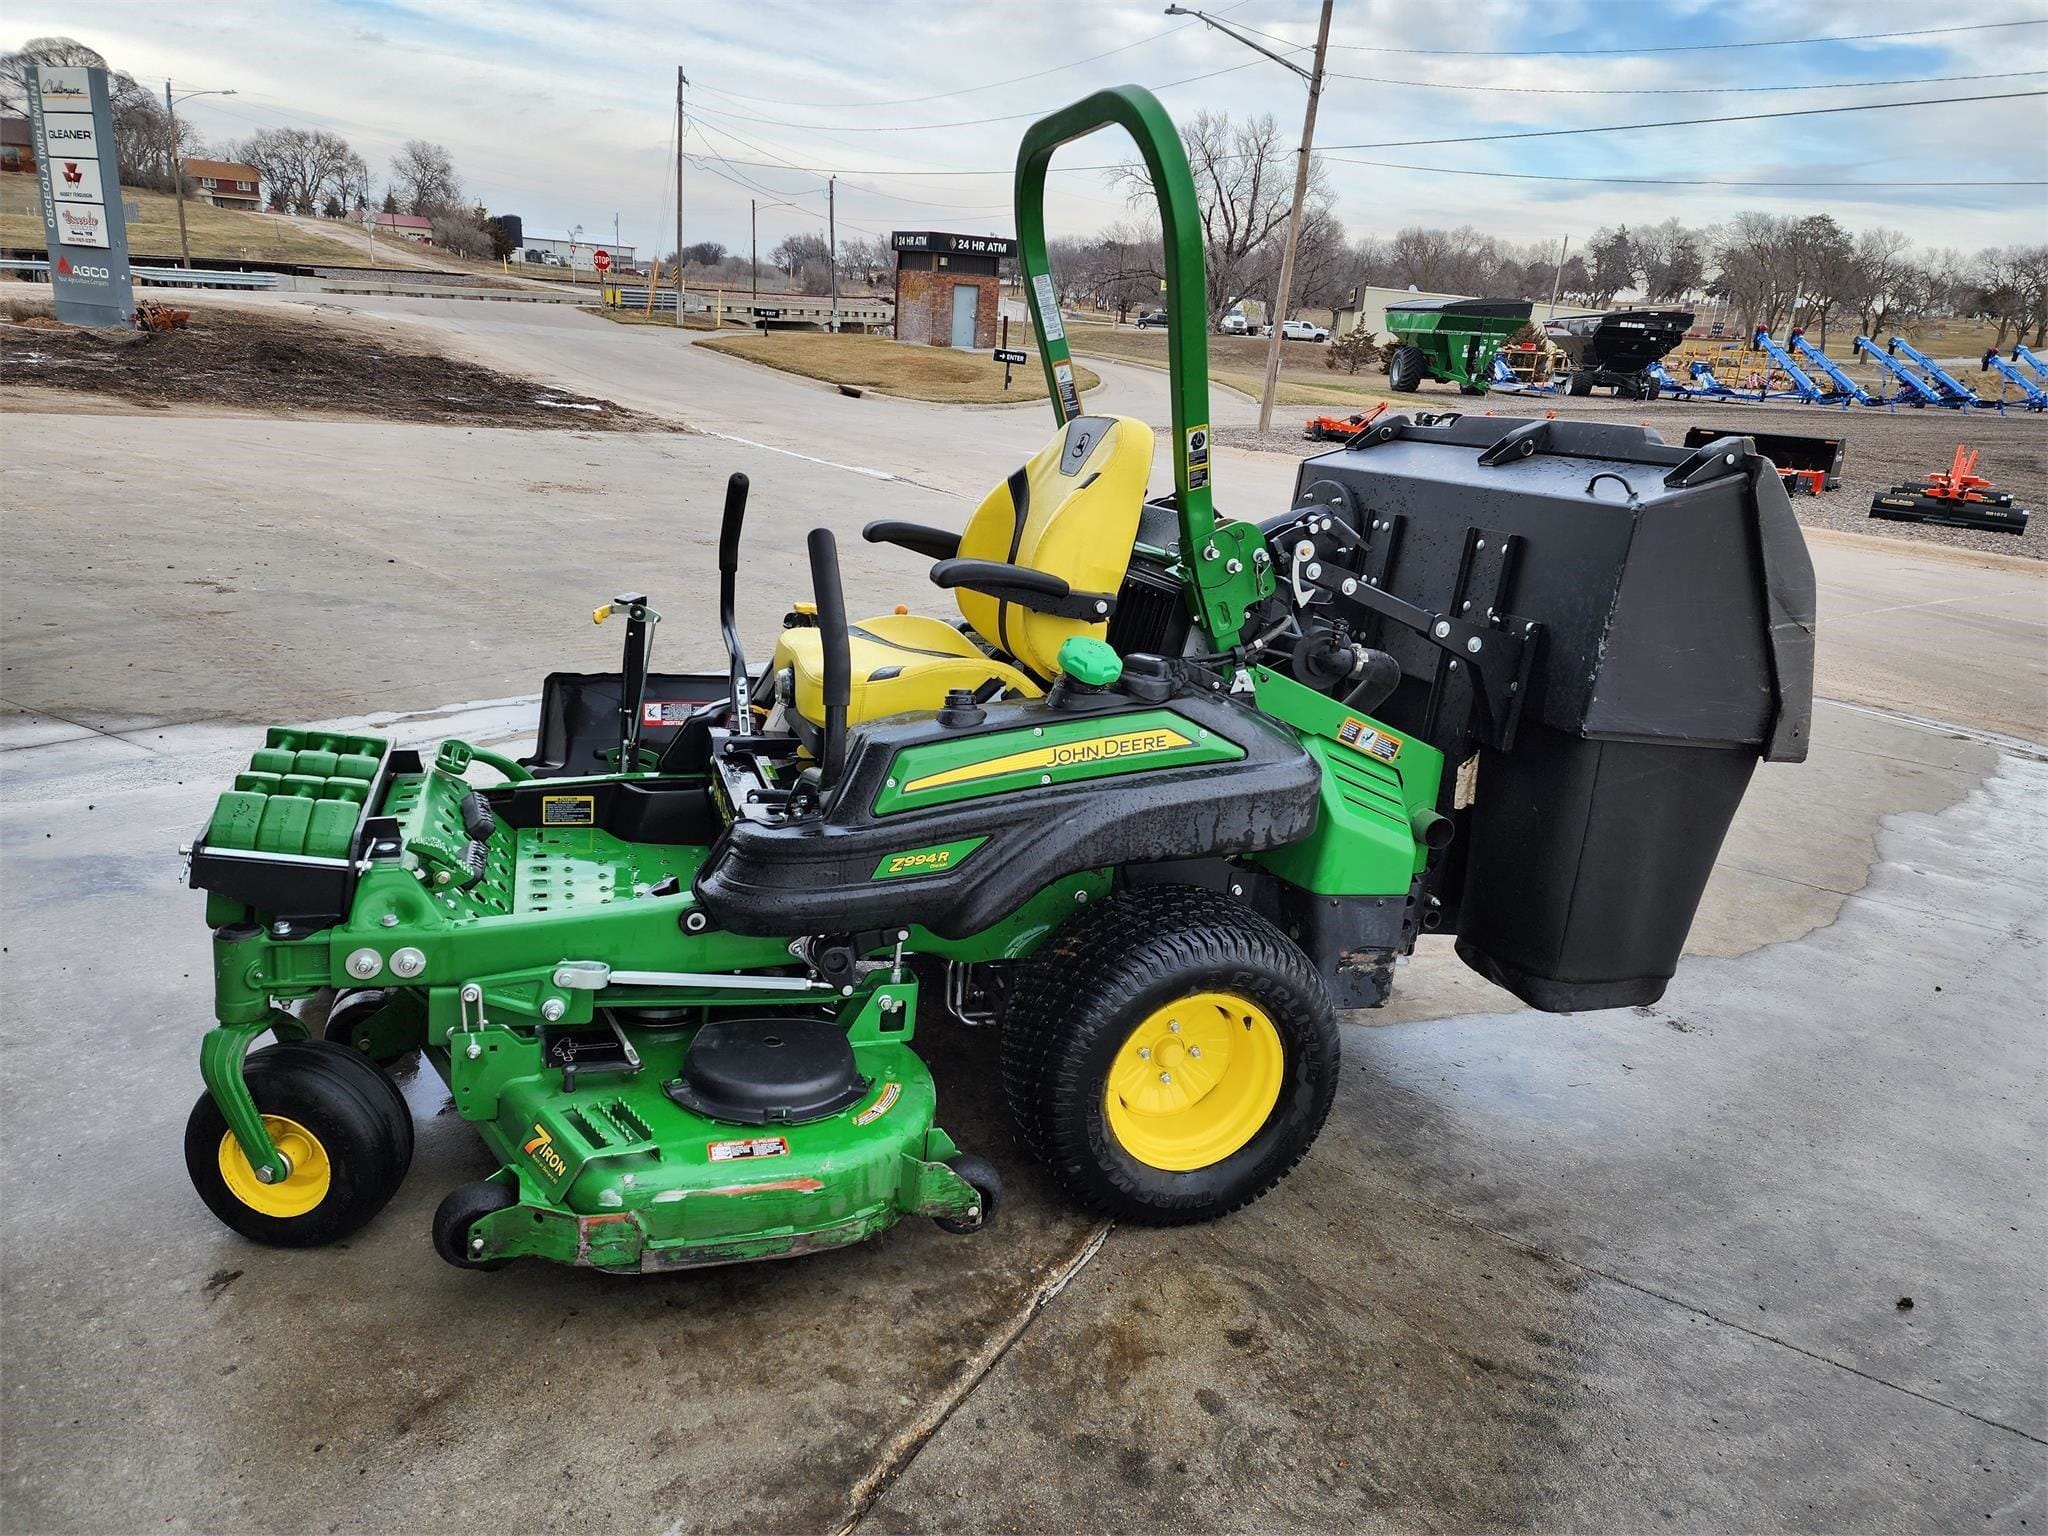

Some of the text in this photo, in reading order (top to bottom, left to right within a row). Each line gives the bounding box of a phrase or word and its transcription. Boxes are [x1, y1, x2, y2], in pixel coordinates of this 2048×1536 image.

[49, 130, 91, 139] GLEANER
[30, 78, 55, 228] OSCEOLA IMPLEMENT
[898, 235, 927, 246] 24 HR ATM
[958, 239, 1007, 253] 24 HR ATM
[594, 256, 610, 265] STOP
[73, 265, 109, 279] AGCO
[1007, 354, 1025, 362] ENTER
[1047, 735, 1167, 765] JOHN DEERE
[888, 851, 950, 873] Z994R
[524, 1123, 566, 1177] 7 IRON
